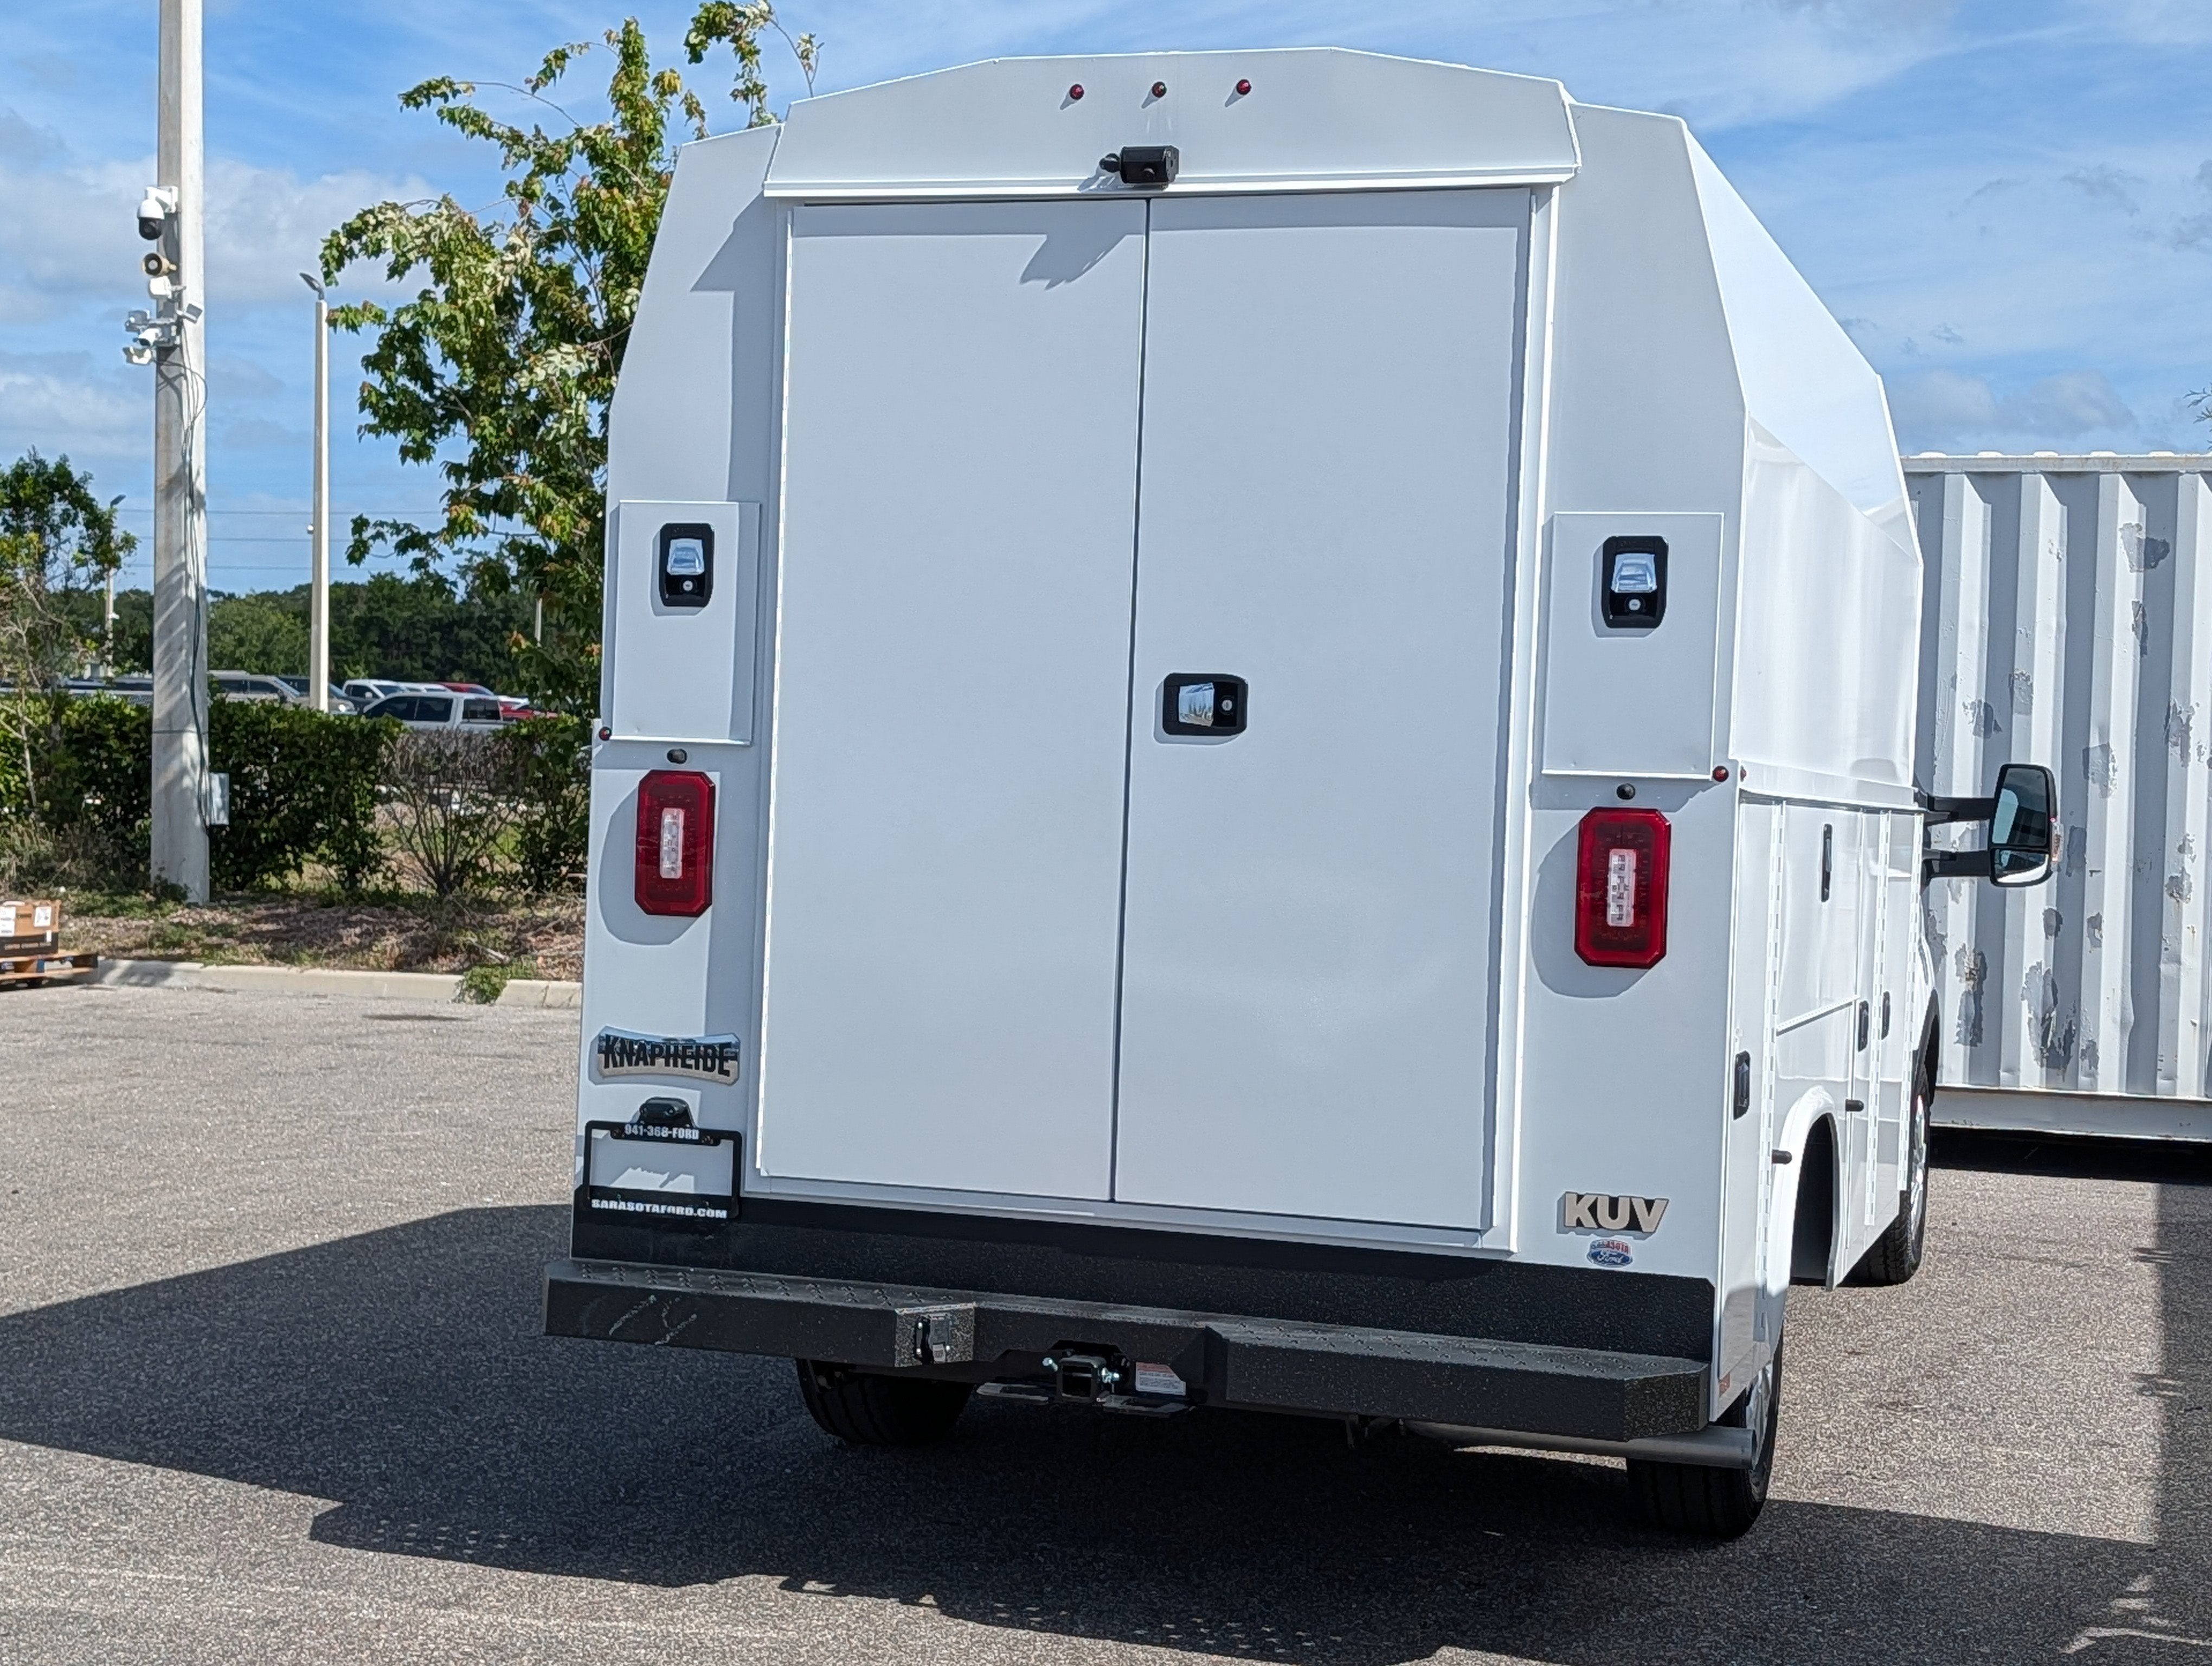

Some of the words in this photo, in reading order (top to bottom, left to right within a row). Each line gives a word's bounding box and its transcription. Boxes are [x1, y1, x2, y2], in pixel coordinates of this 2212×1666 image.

[603, 1034, 732, 1077] KNAPHEIDE
[624, 1125, 699, 1139] 941-368-FORD
[591, 1199, 727, 1219] SARASOTAFORD.COM
[1565, 1191, 1669, 1233] KUV
